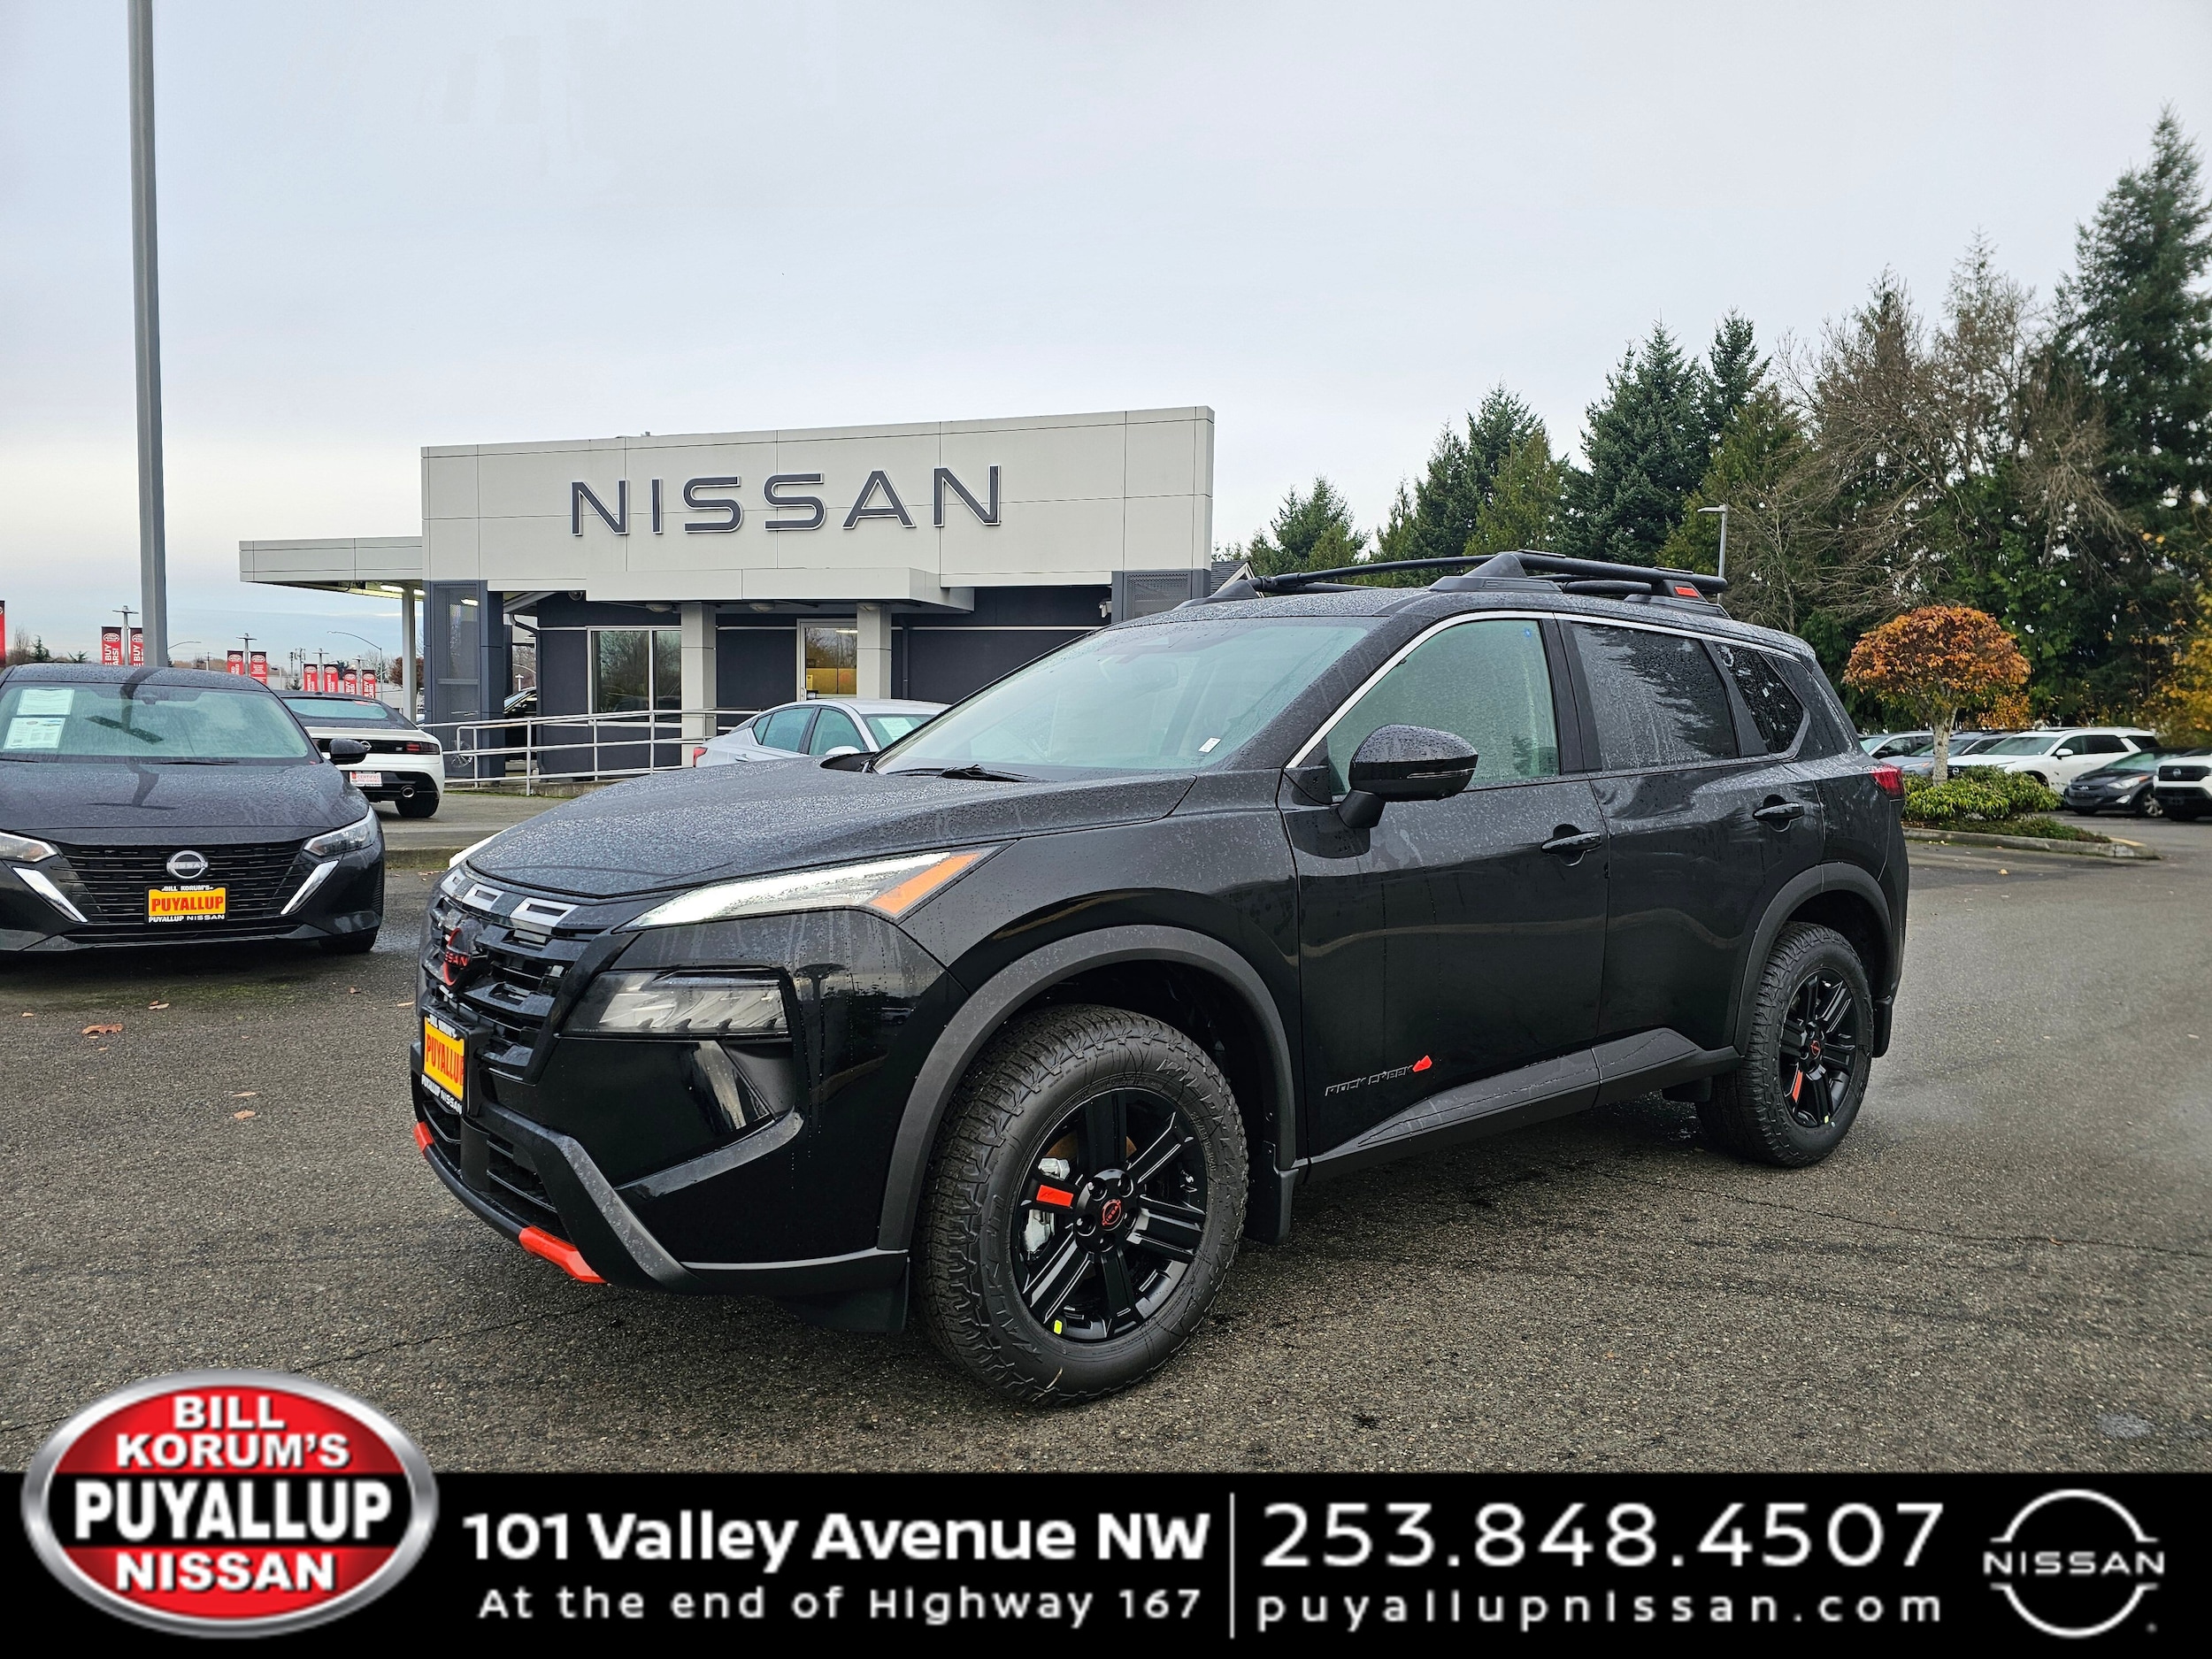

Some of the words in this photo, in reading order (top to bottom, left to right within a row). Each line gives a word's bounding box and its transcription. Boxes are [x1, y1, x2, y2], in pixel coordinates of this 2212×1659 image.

[571, 465, 1001, 536] NISSAN
[166, 861, 209, 870] NISSAN
[151, 895, 224, 912] PUYALLUP
[441, 1090, 463, 1115] NISSAN
